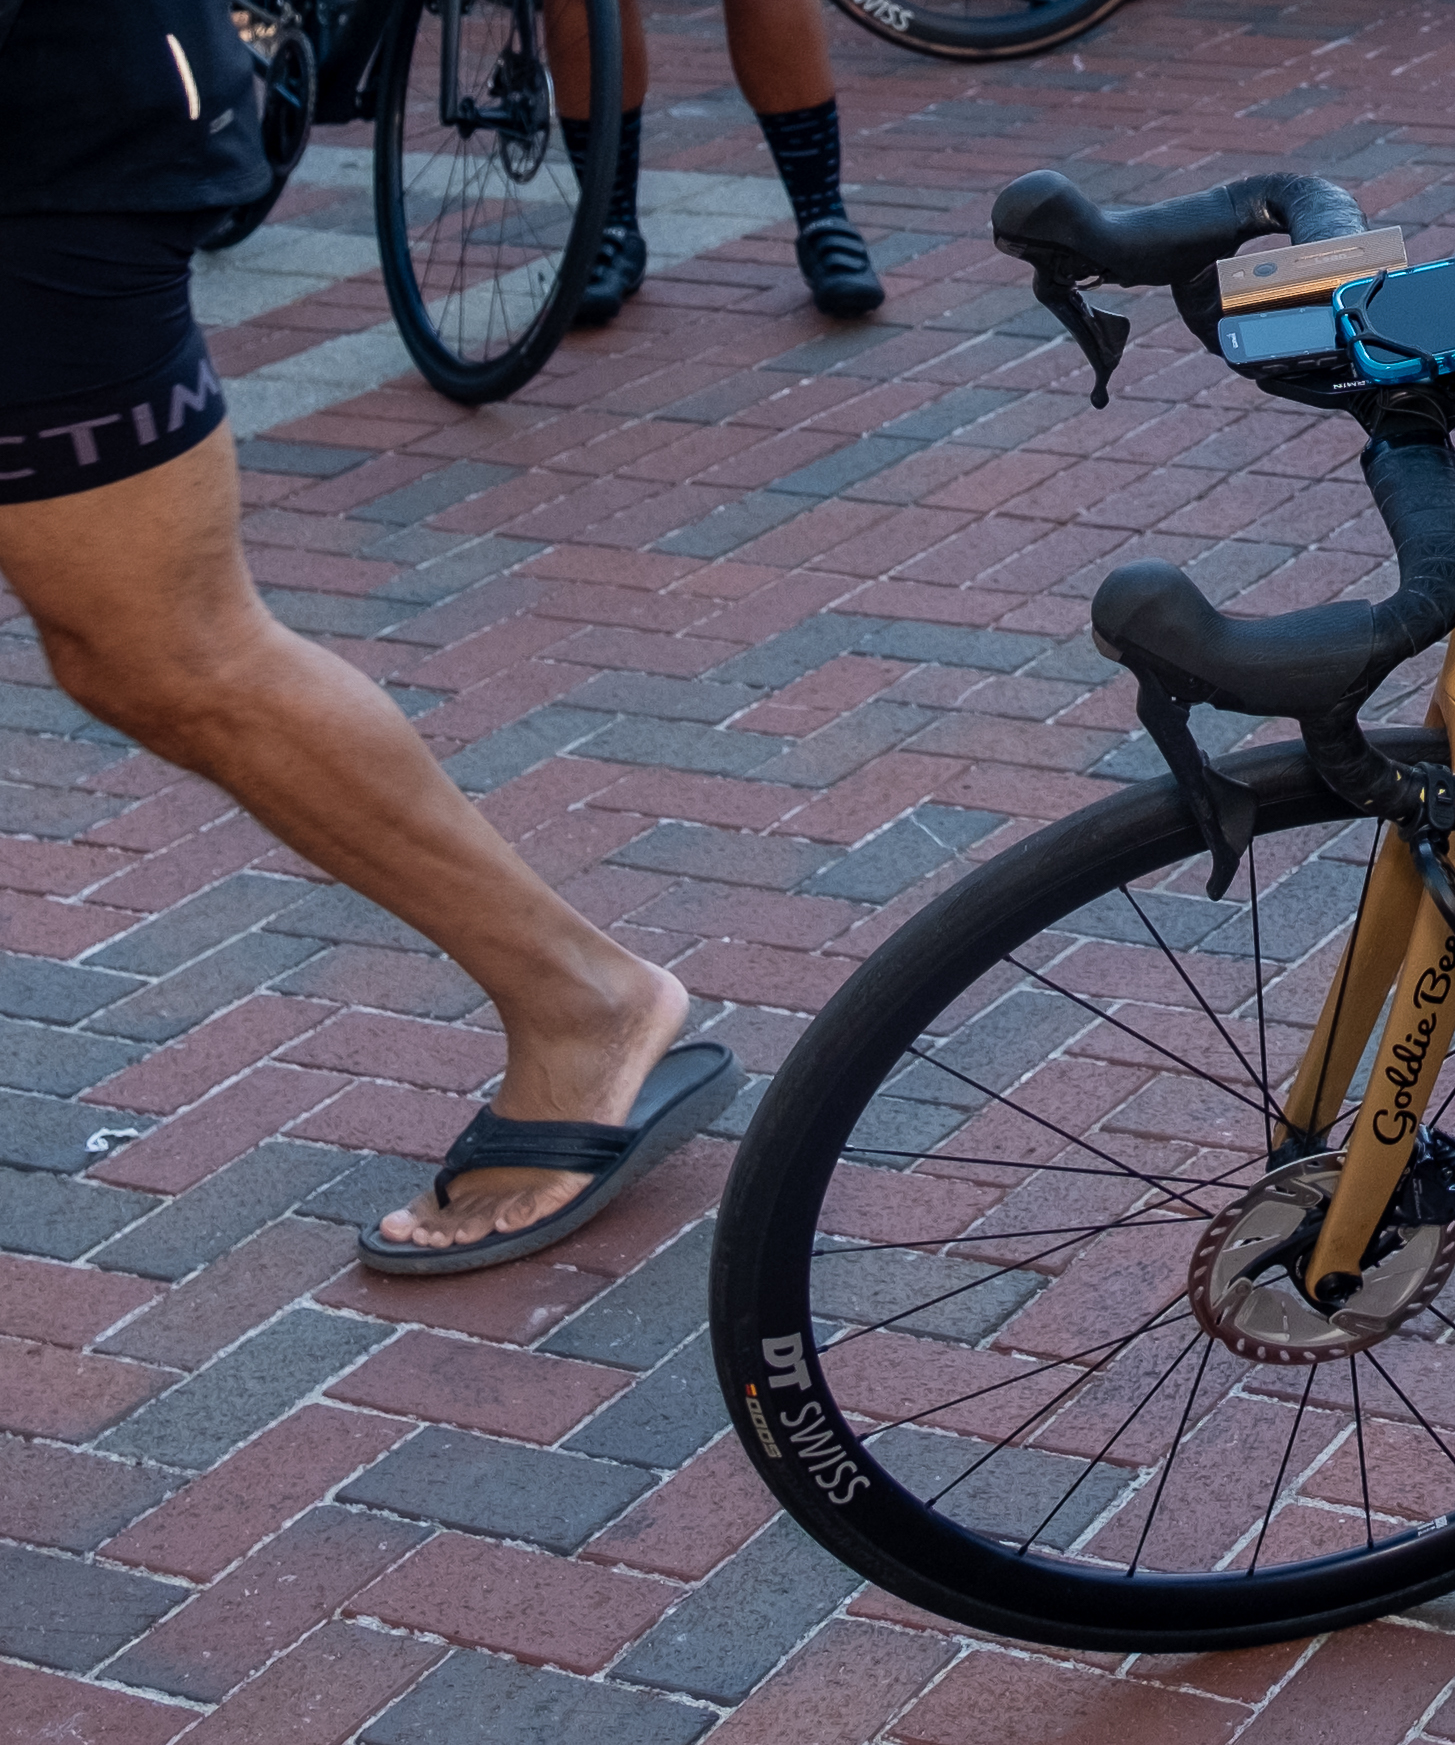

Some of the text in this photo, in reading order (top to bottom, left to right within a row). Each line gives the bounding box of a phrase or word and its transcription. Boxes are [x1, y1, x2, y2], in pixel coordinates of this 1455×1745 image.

[1372, 1012, 1437, 1146] Goldie
[762, 1331, 871, 1504] DT SWISS
